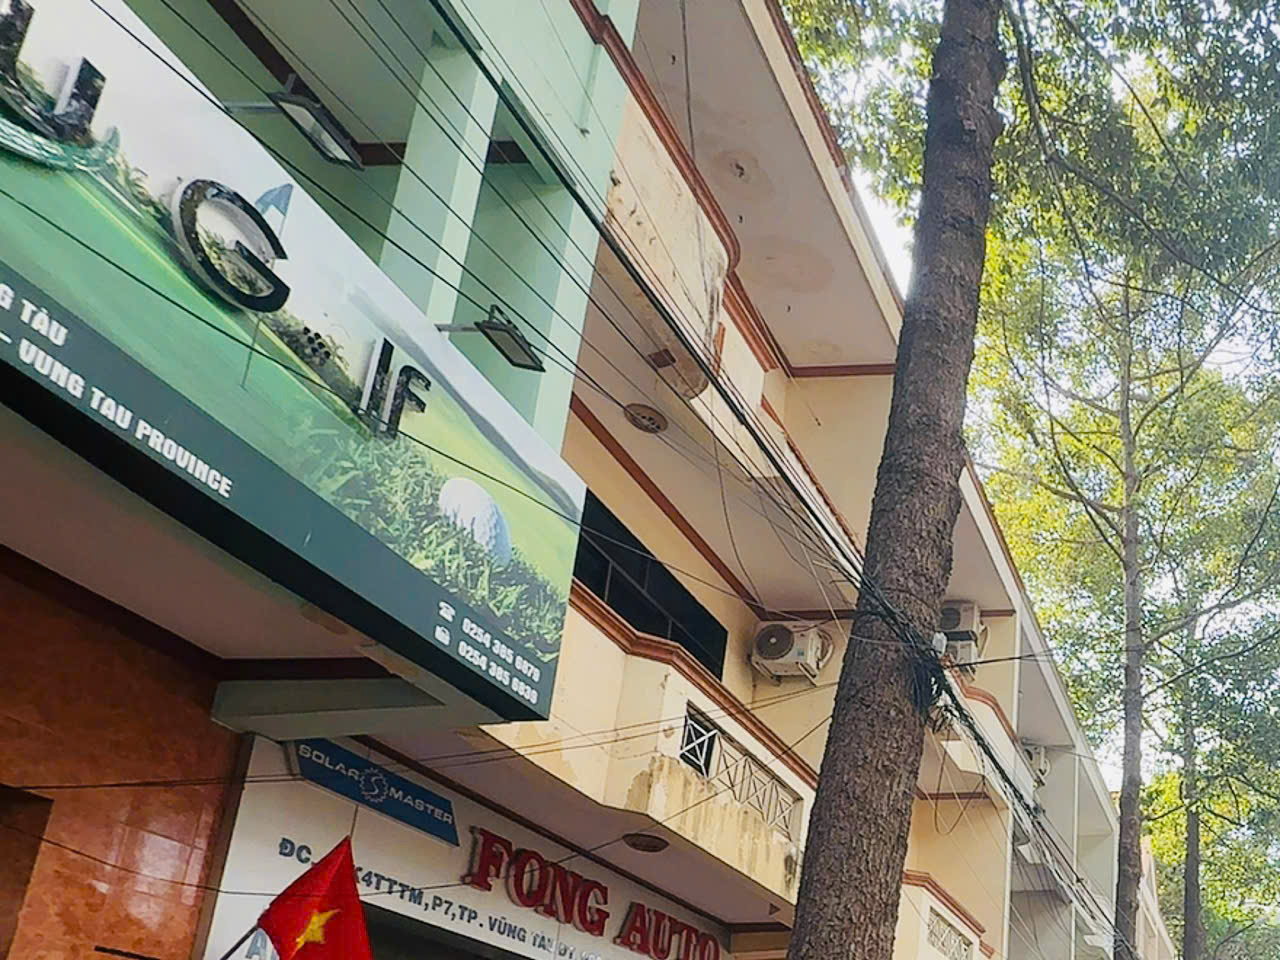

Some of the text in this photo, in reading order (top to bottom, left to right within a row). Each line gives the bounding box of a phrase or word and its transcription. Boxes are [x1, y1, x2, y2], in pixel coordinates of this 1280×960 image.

[20, 299, 68, 346] TÀU
[90, 387, 133, 430] TAU
[135, 419, 233, 499] PROVINCE
[298, 744, 359, 781] SOLAR
[388, 787, 453, 824] MASTER
[461, 825, 610, 937] FONG
[488, 916, 527, 942] VŨNG
